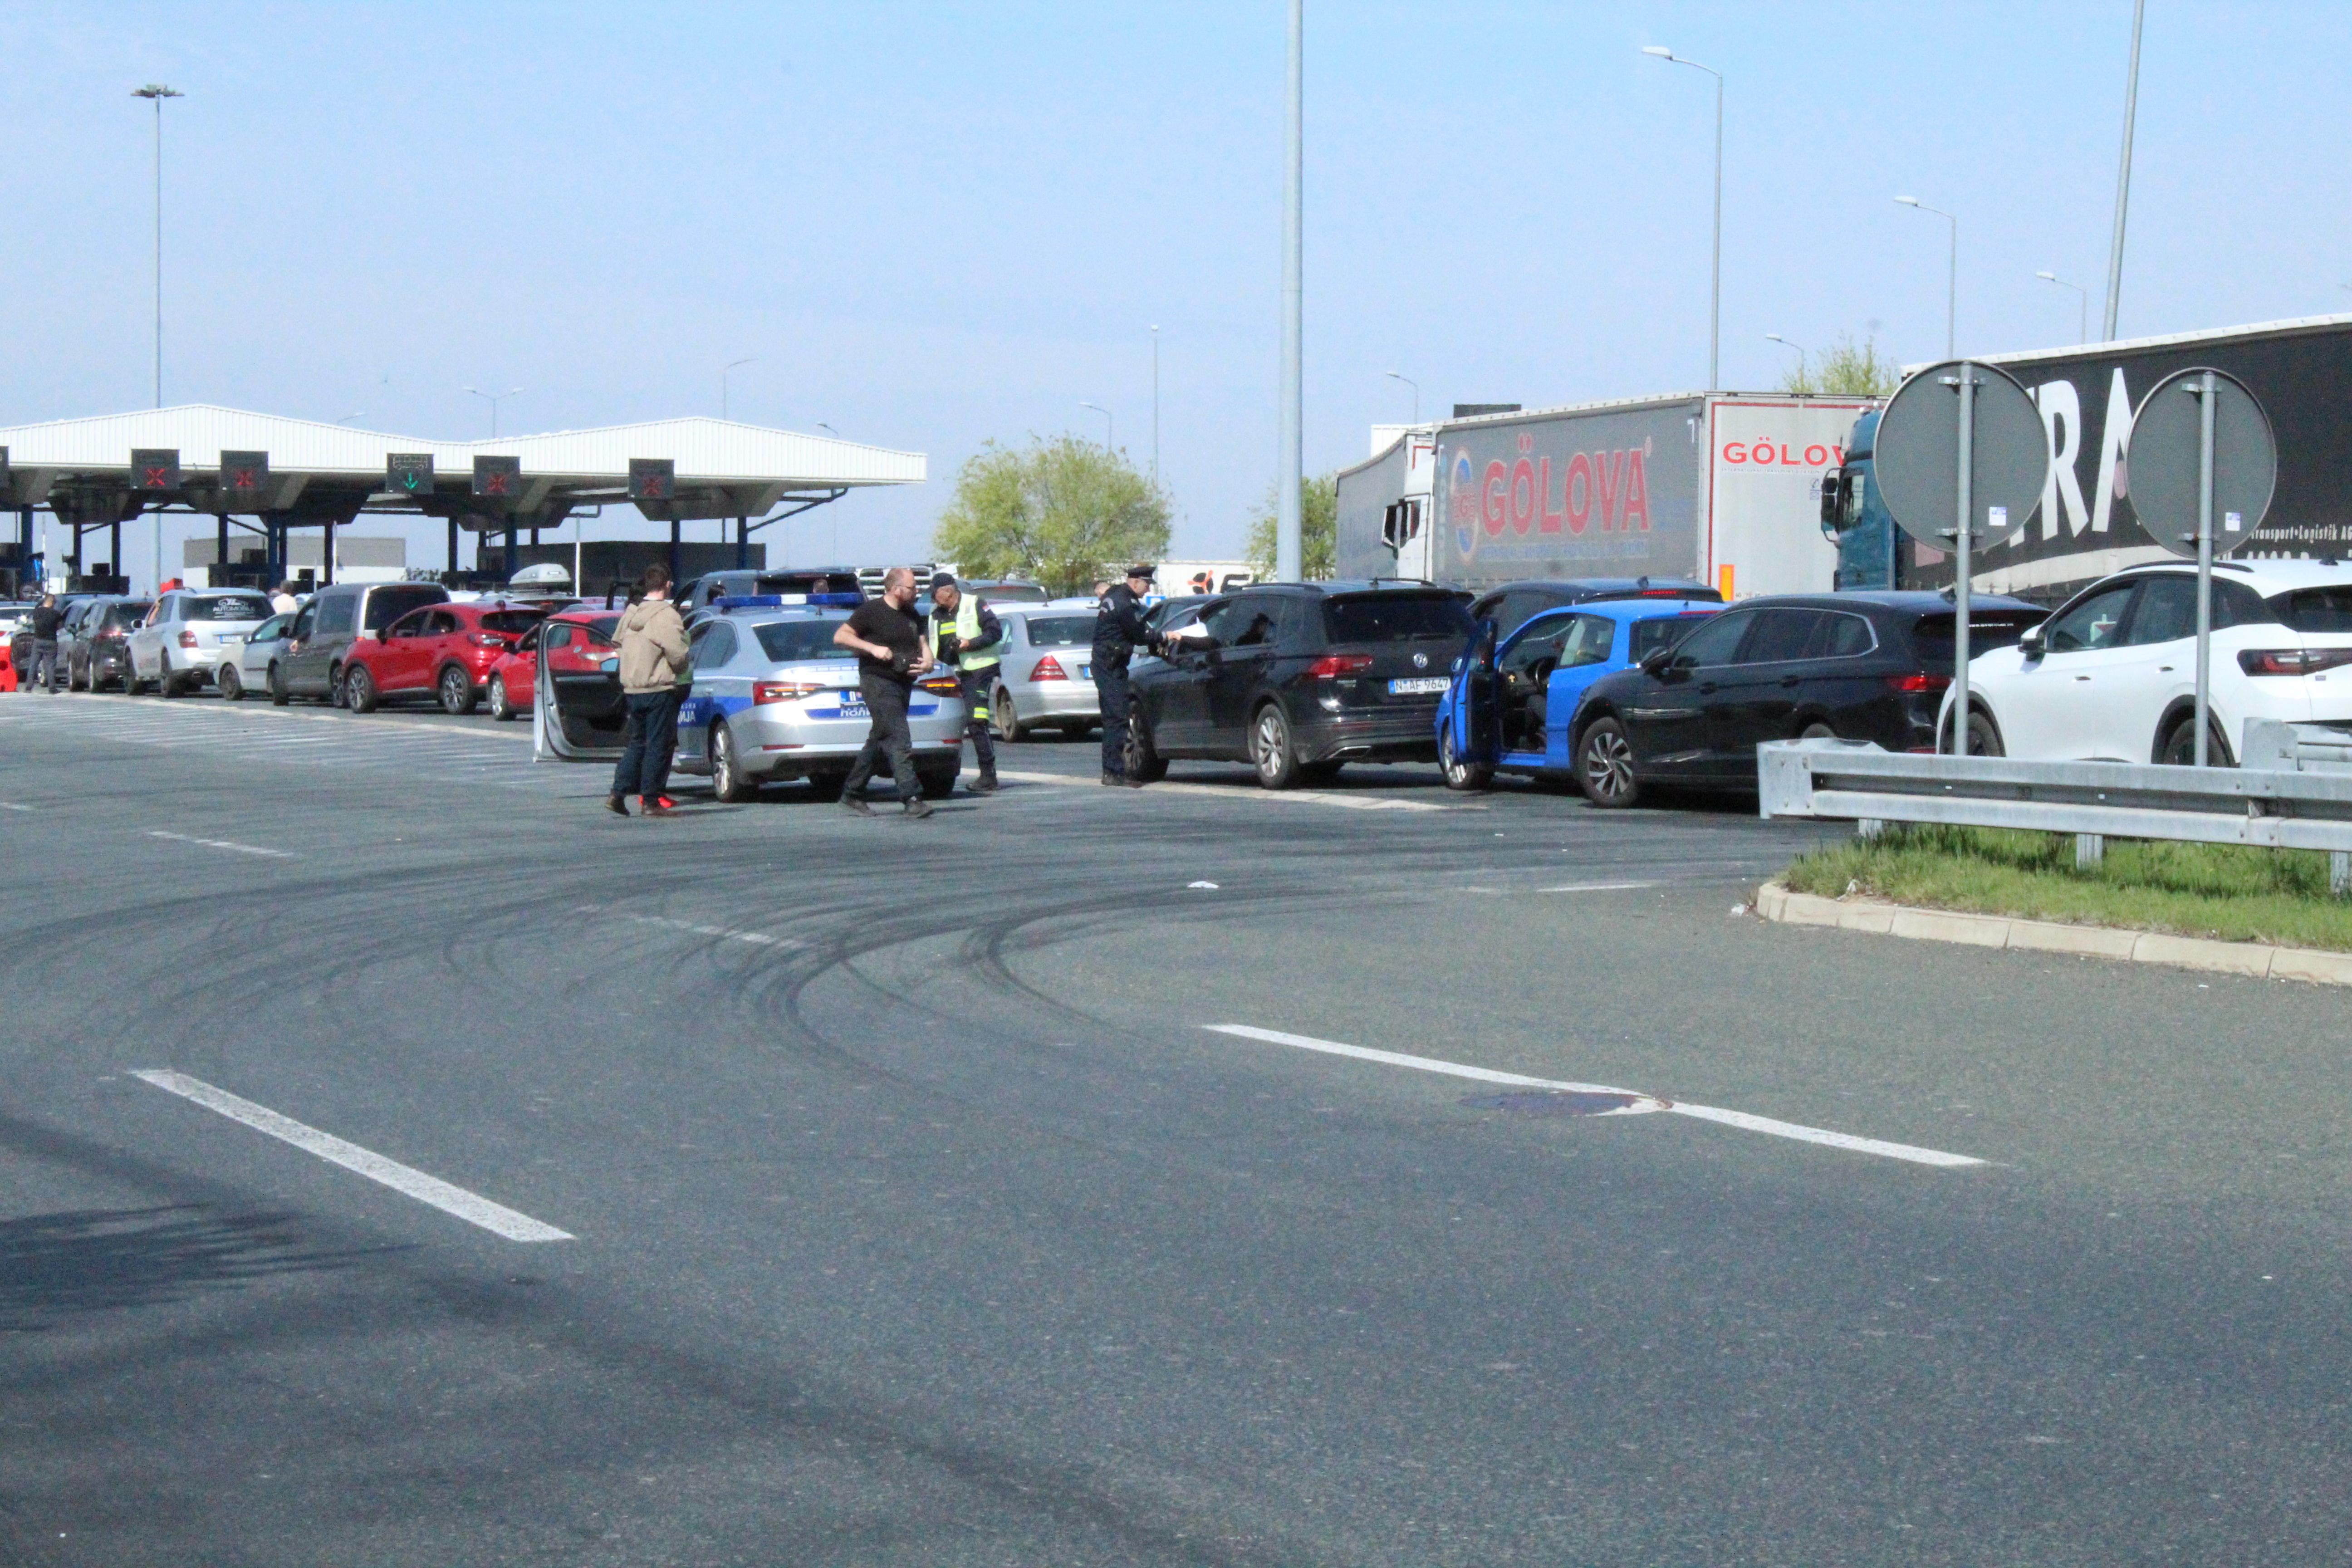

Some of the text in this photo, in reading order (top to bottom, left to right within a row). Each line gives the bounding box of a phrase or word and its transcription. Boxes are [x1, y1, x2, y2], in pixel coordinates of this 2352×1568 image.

[1723, 436, 1851, 466] GÖLOV
[1482, 432, 1650, 537] GÖLOVA
[1396, 678, 1449, 691] N AF 9647
